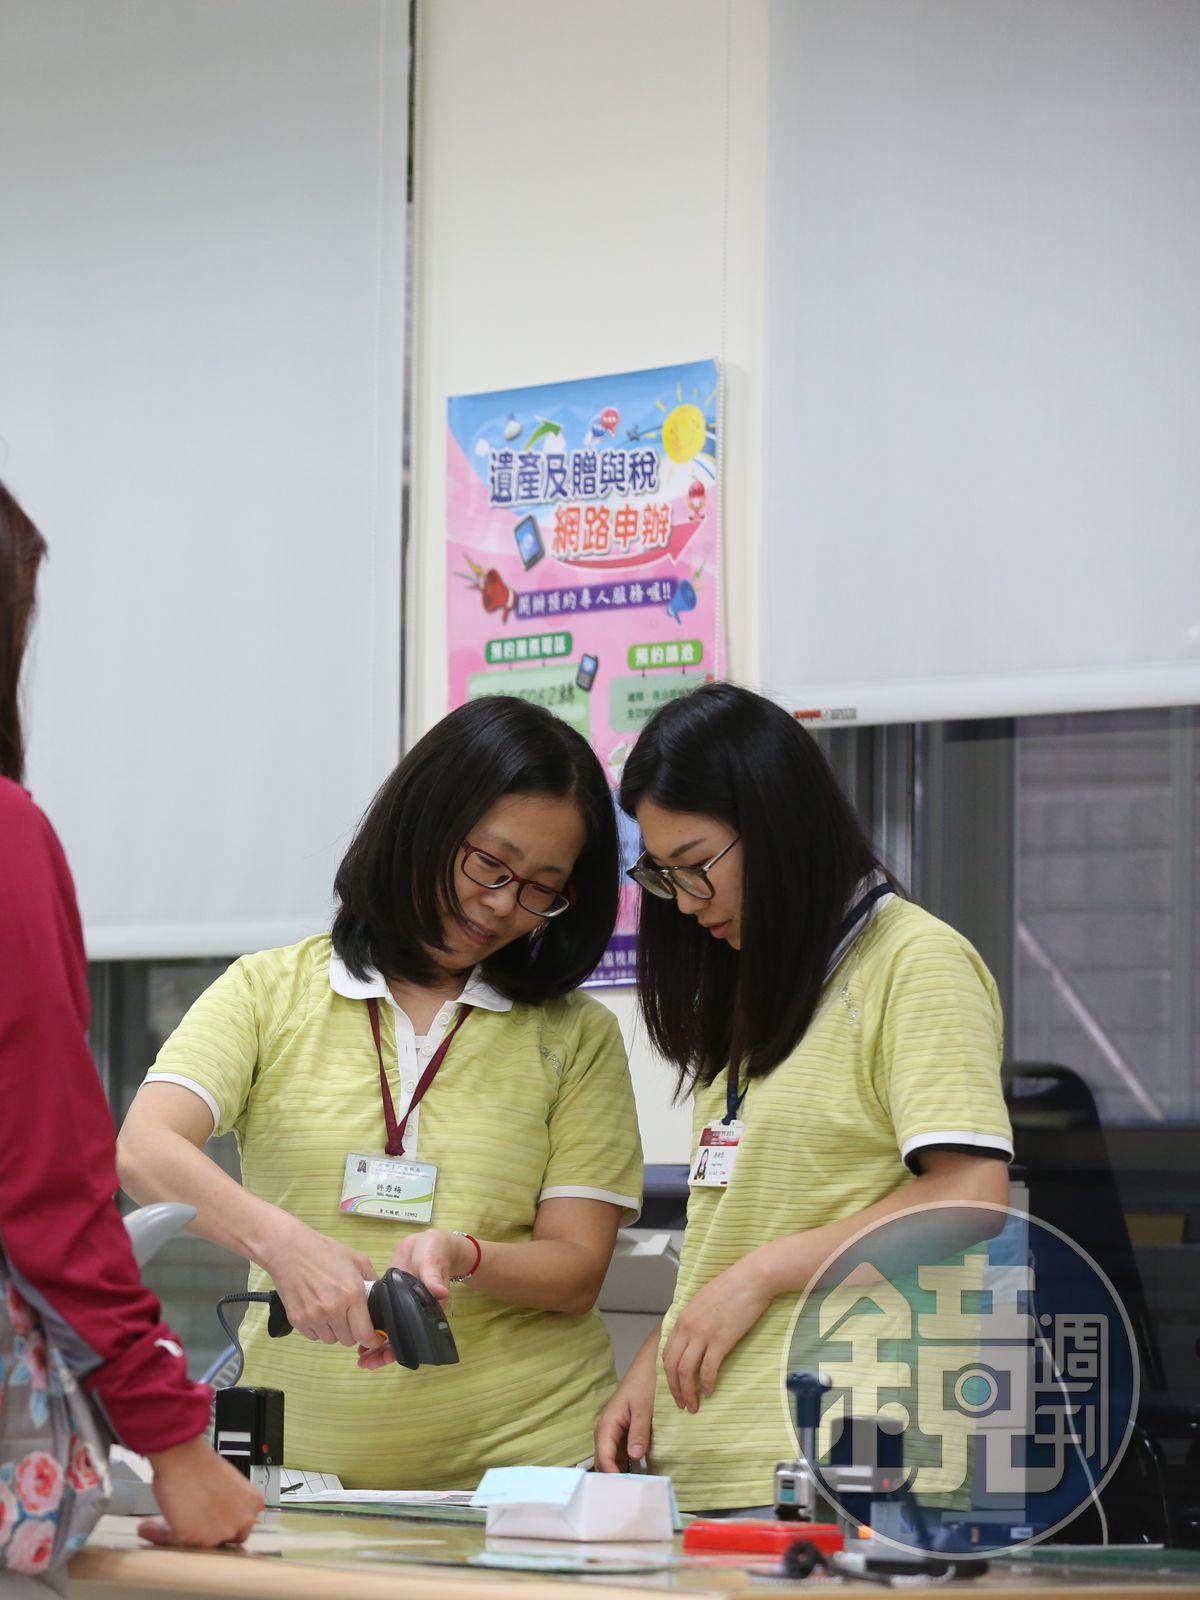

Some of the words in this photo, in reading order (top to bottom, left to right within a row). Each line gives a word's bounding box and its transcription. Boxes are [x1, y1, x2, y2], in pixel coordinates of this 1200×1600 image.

[489, 450, 657, 503] 遺產及贈與稅
[552, 503, 671, 554] 網路申辦
